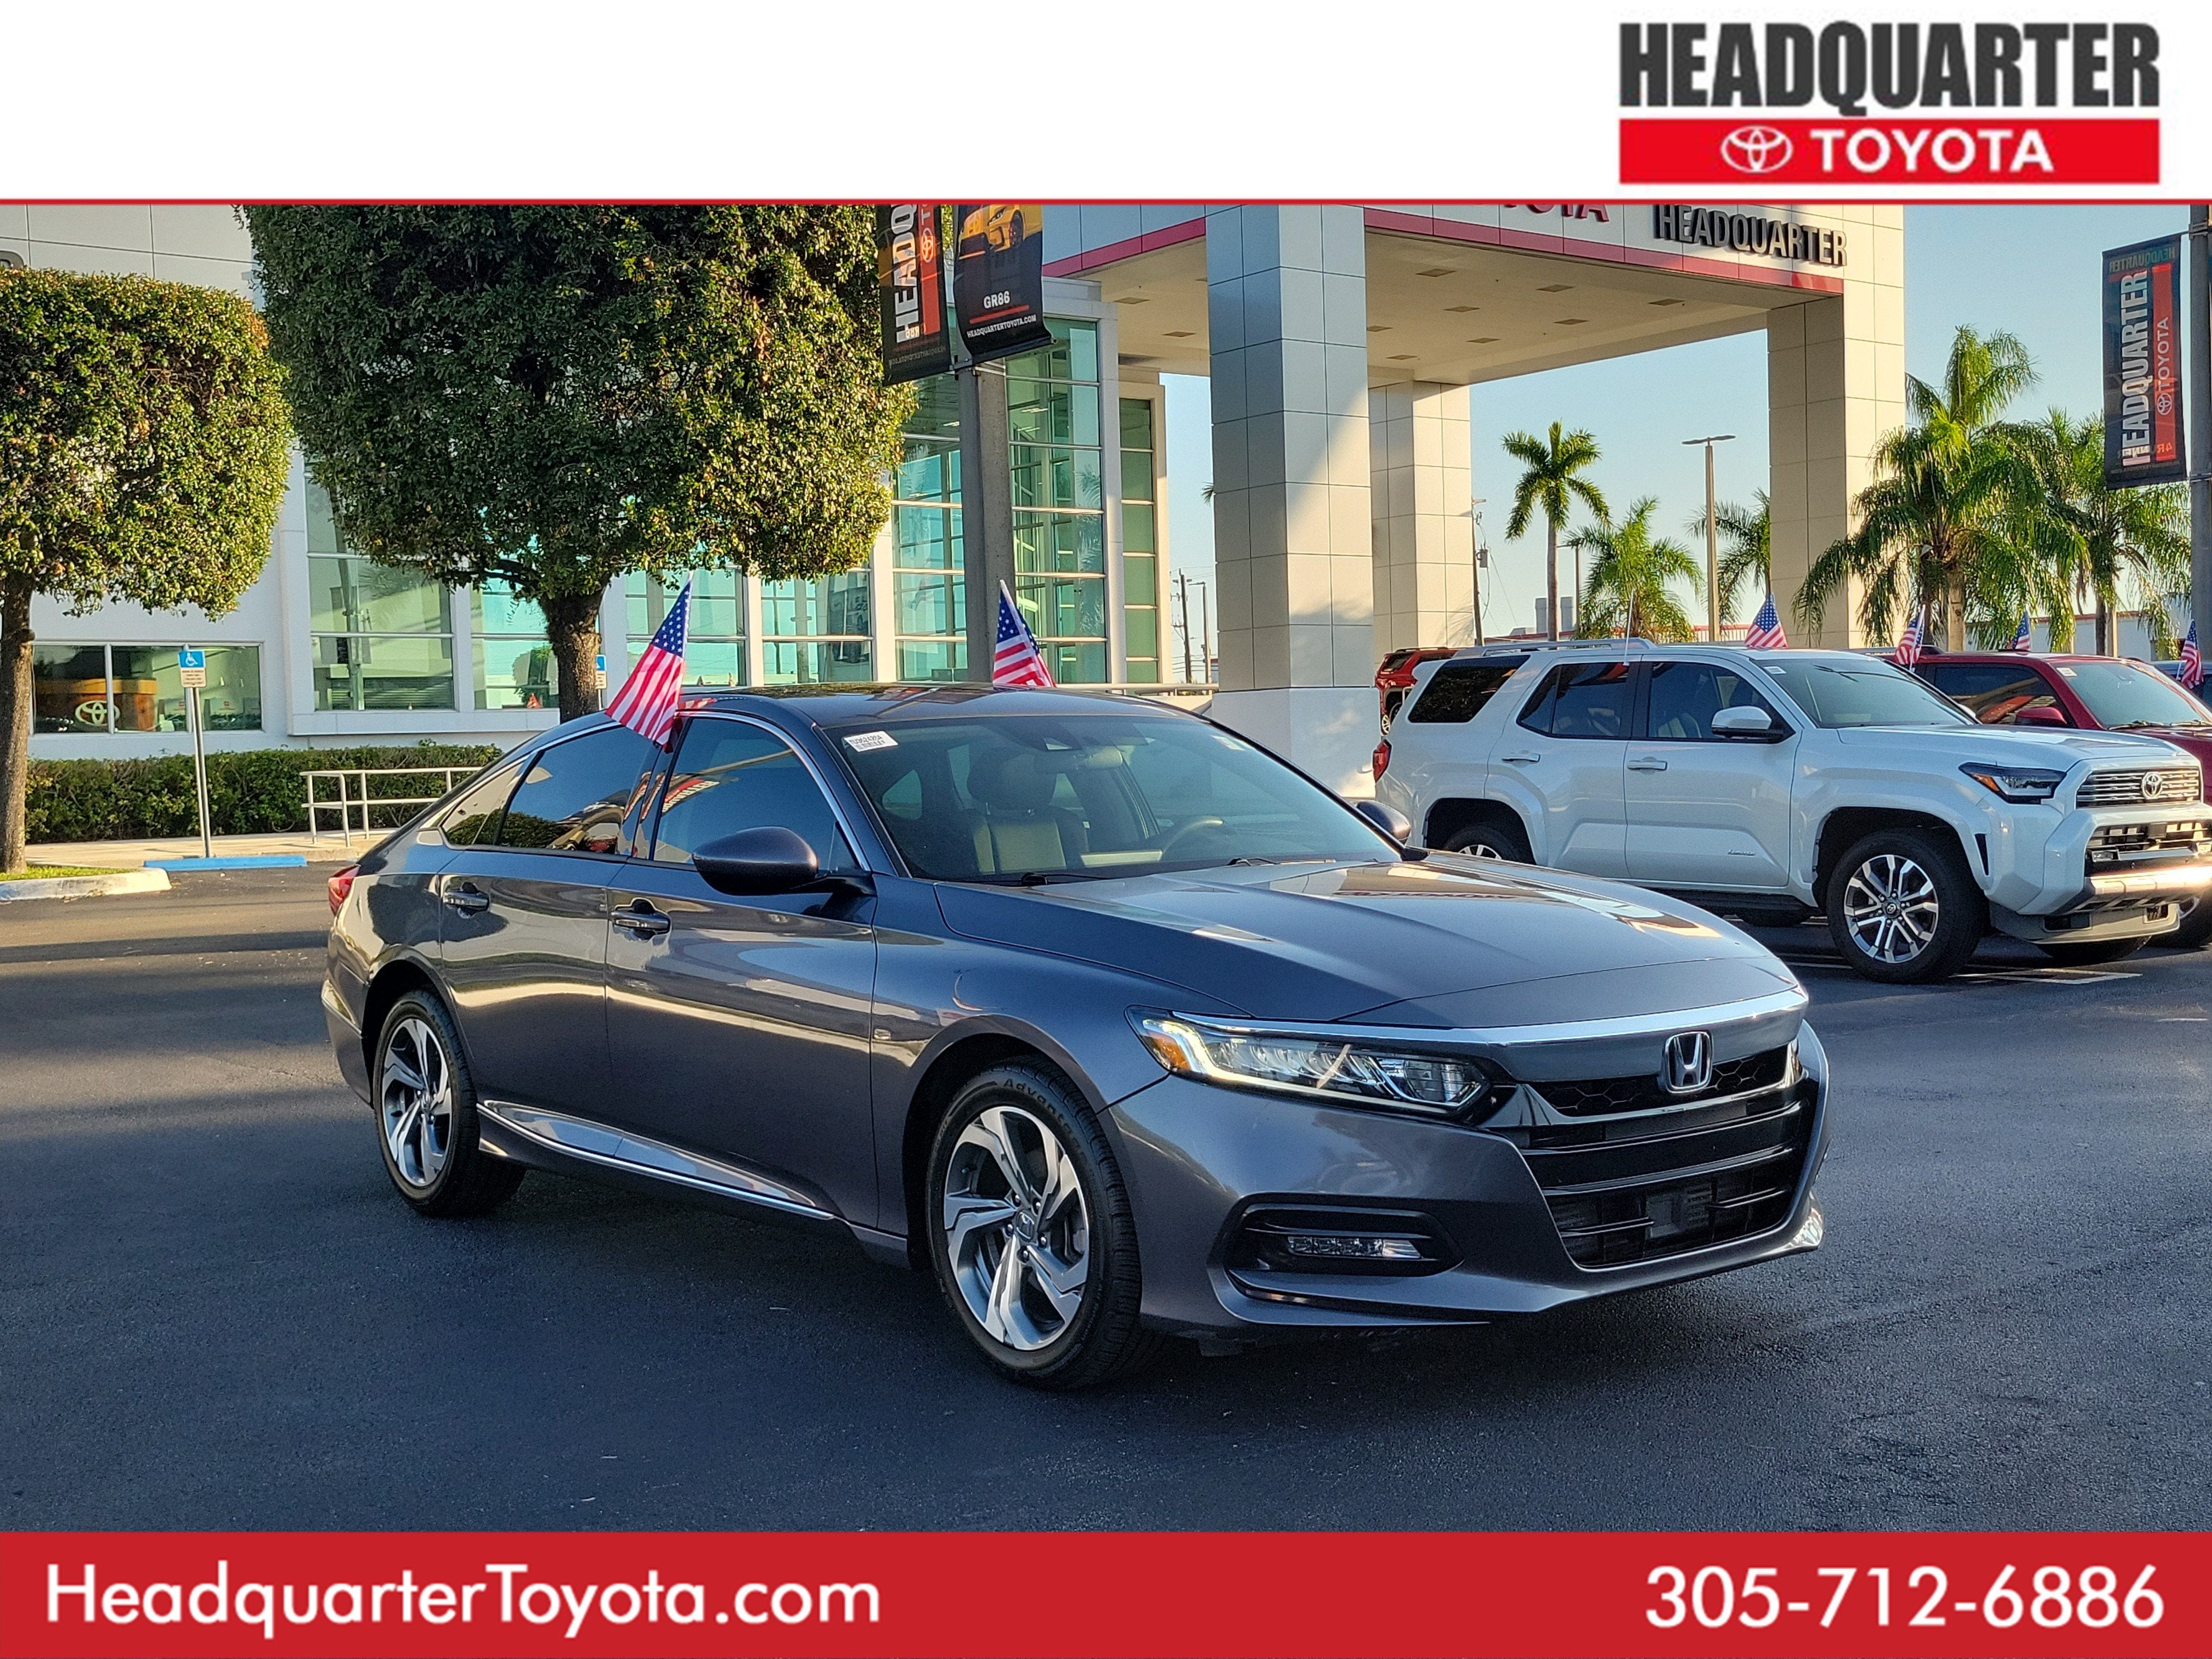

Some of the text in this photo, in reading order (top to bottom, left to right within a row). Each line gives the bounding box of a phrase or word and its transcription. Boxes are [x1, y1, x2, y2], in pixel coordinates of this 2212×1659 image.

[1653, 204, 1847, 267] HEADQUARTER
[966, 314, 1037, 338] HEADQUARTERTOYOTA.COM
[983, 290, 1011, 309] GR86
[2121, 269, 2153, 466] HEADQUARTER
[2157, 317, 2170, 392] TOYOTA
